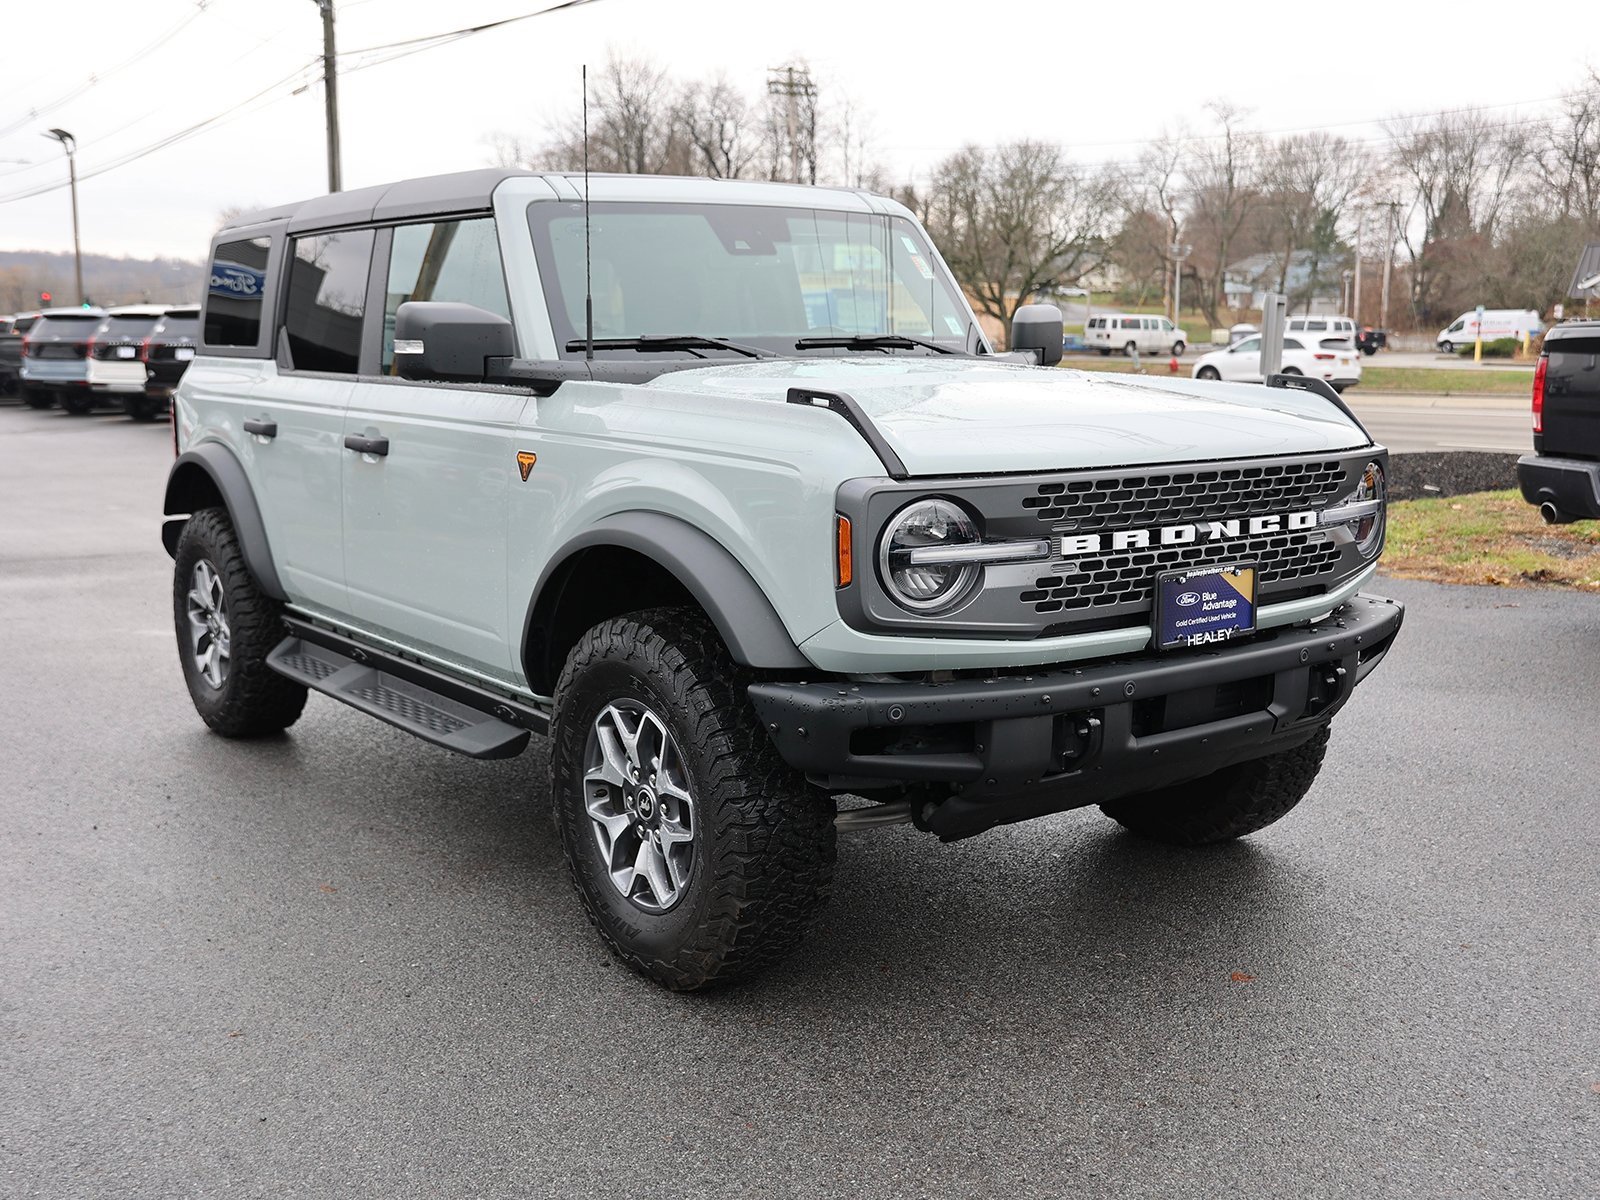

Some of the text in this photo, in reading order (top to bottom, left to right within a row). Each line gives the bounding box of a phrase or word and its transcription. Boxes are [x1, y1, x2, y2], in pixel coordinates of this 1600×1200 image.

[1061, 511, 1317, 555] BRONCO
[1202, 592, 1217, 601] Blue
[1202, 599, 1237, 611] Advantage
[1188, 616, 1208, 626] Certified
[1209, 614, 1221, 622] Used
[1221, 612, 1237, 620] Vehicle
[1187, 628, 1232, 646] HEALEY
